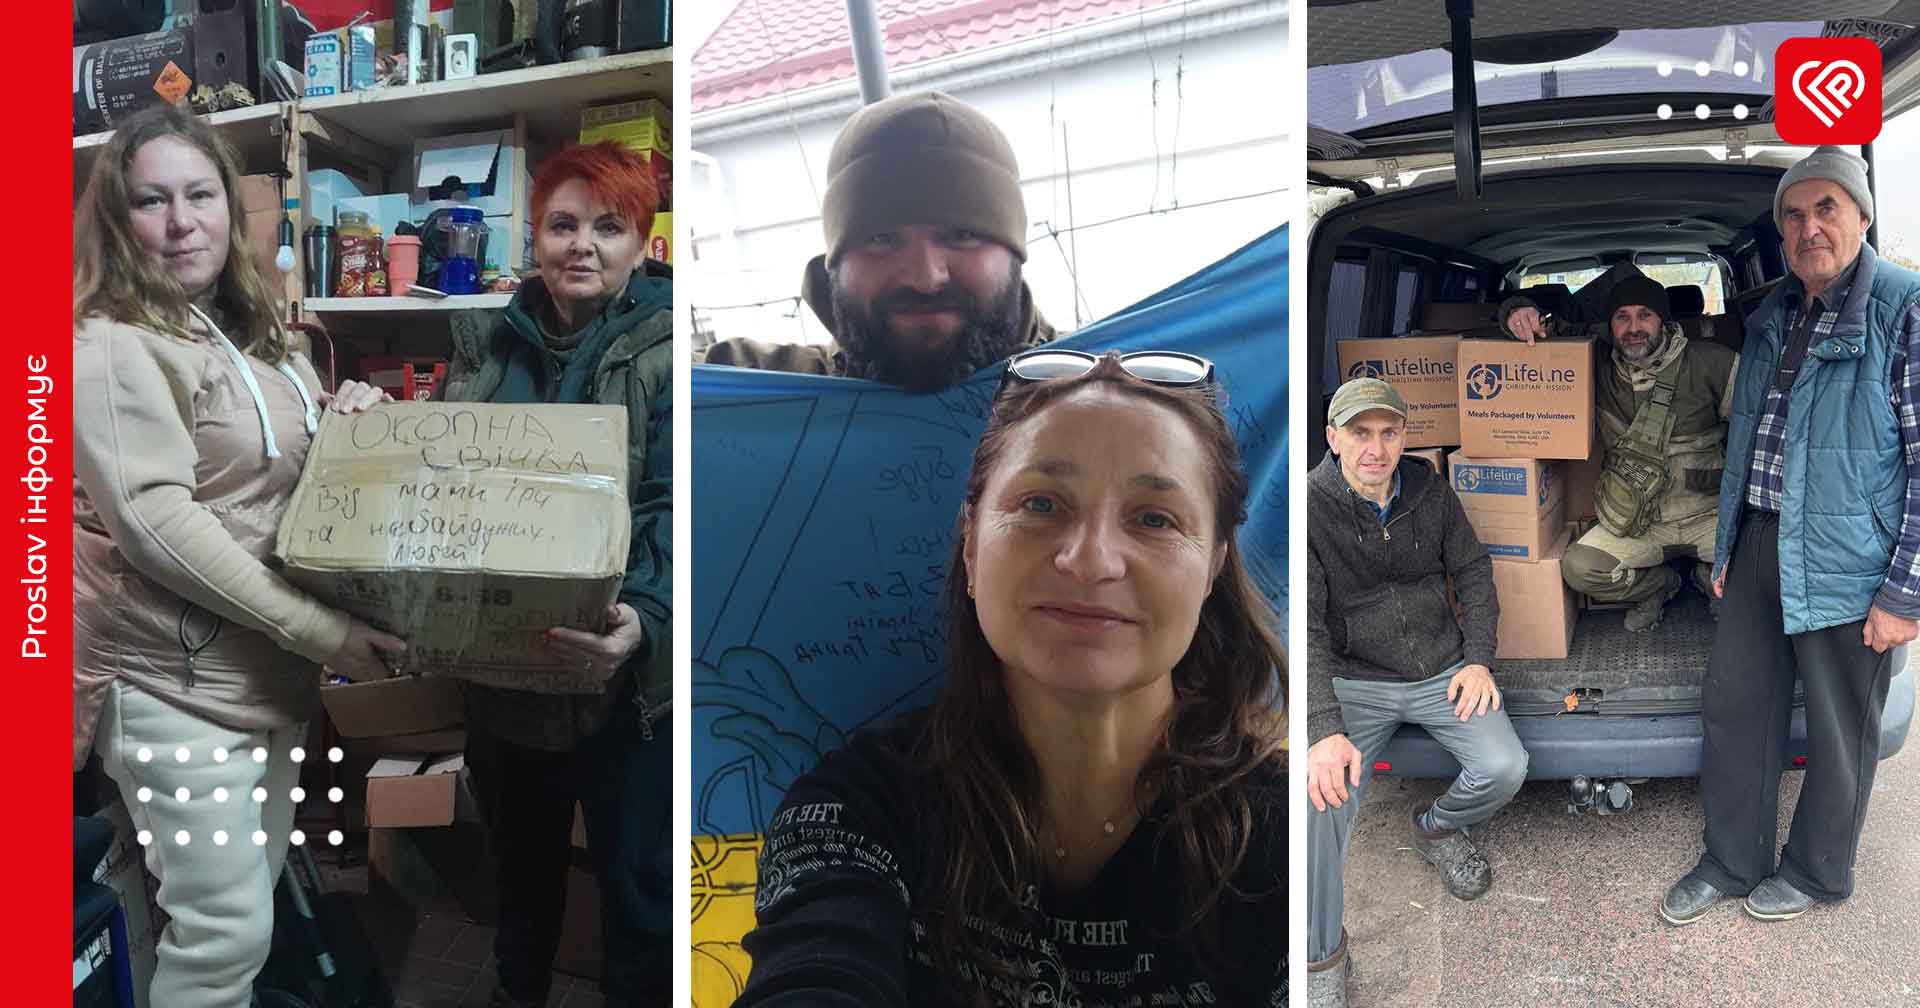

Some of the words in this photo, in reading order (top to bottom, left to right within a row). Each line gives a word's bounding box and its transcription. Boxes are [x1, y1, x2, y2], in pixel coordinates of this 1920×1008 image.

[1385, 358, 1454, 376] Lifeline
[1504, 364, 1575, 383] Lifelne
[1467, 410, 1489, 418] Meals
[1490, 411, 1524, 420] Packaged
[1526, 412, 1536, 421] by
[1536, 412, 1575, 420] Volunteers
[350, 410, 554, 450] ОКОПНА
